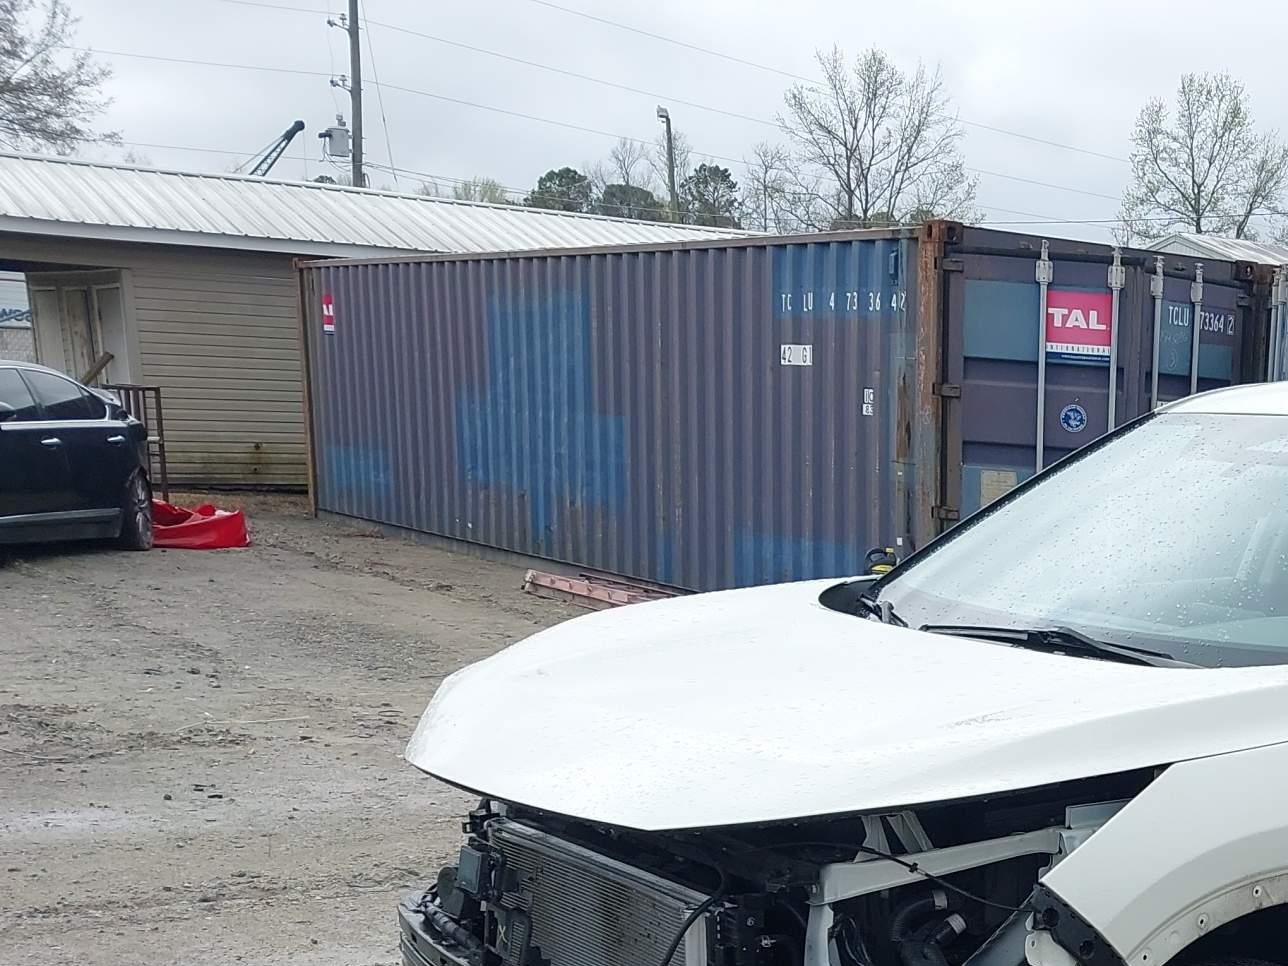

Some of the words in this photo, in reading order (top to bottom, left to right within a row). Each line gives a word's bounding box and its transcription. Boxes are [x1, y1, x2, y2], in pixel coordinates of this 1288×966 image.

[1048, 307, 1107, 330] TAL
[1168, 306, 1190, 326] TCLU
[1047, 344, 1111, 355] NTERNATIONAL
